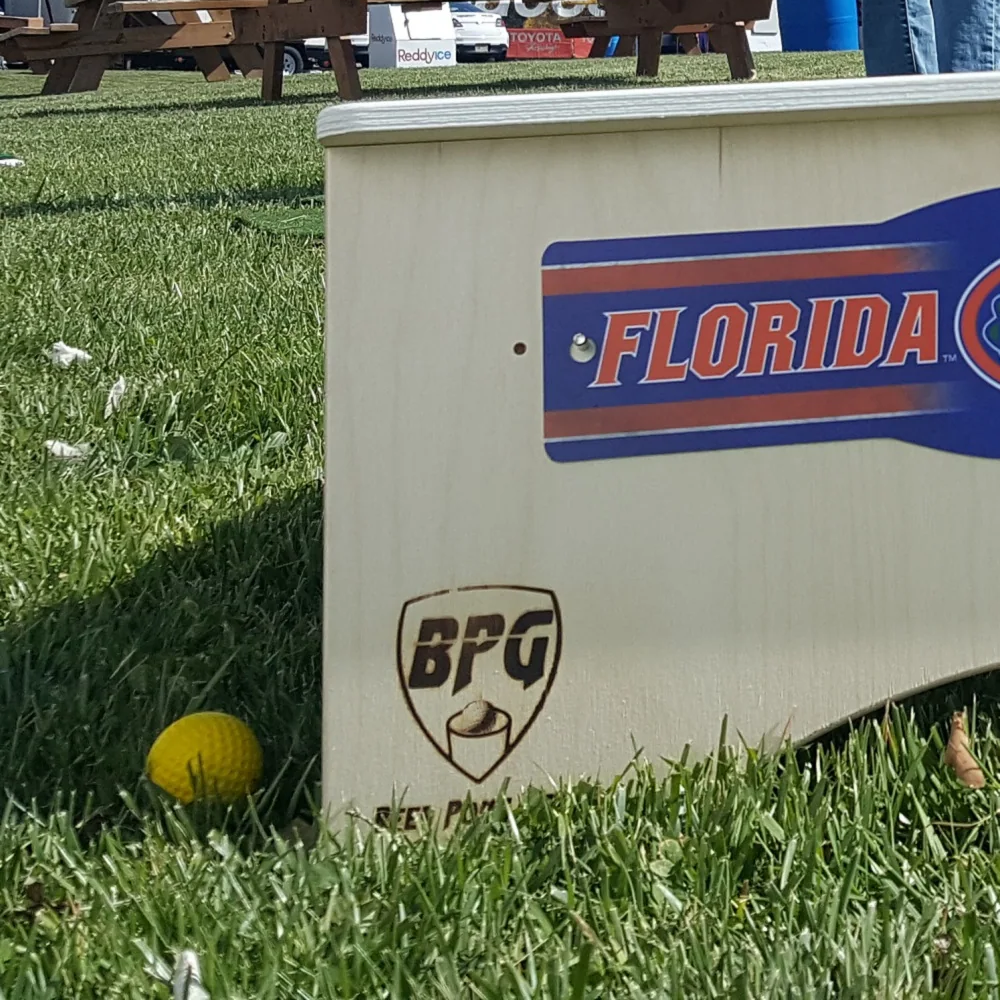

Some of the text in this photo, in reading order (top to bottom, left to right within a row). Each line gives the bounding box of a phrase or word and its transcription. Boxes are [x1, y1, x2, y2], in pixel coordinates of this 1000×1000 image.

[510, 32, 561, 43] TOYOTA
[587, 290, 939, 388] FLORIDA
[408, 609, 554, 697] BPG
